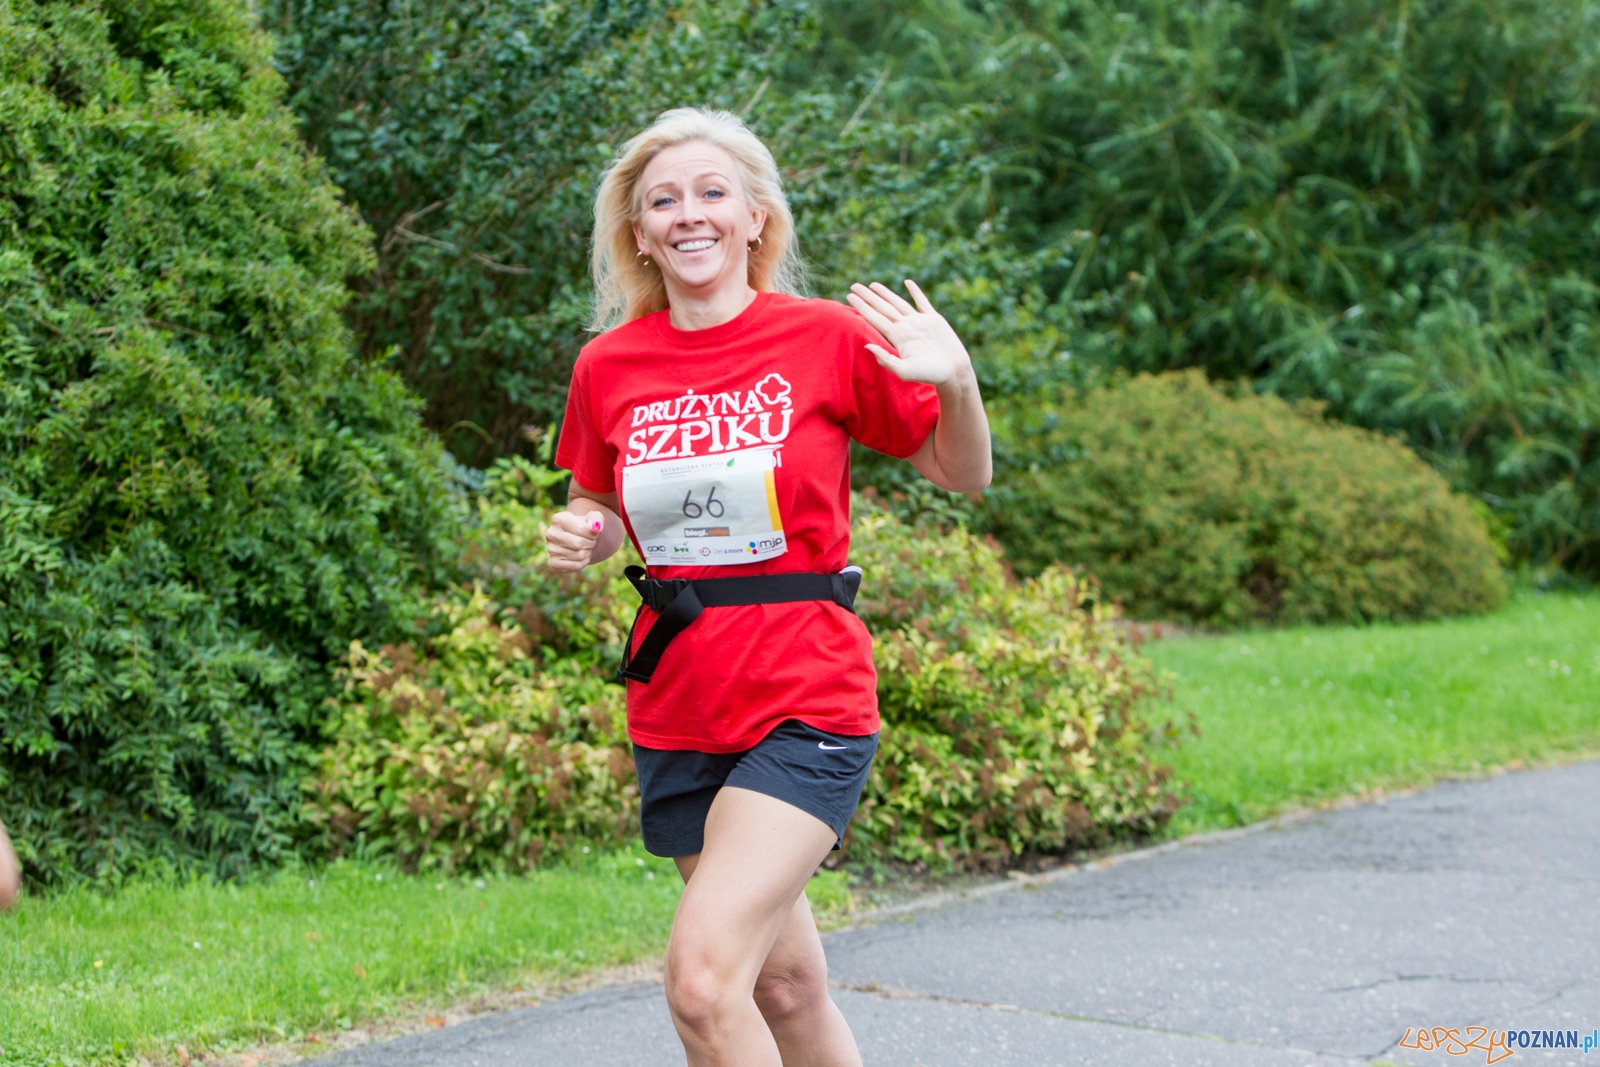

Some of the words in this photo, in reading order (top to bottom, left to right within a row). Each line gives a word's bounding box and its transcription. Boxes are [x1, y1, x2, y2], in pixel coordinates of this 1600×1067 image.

[631, 389, 764, 427] DRUŻYNA
[626, 409, 794, 466] SZPIKU
[682, 486, 724, 519] 66
[759, 537, 783, 548] mjp
